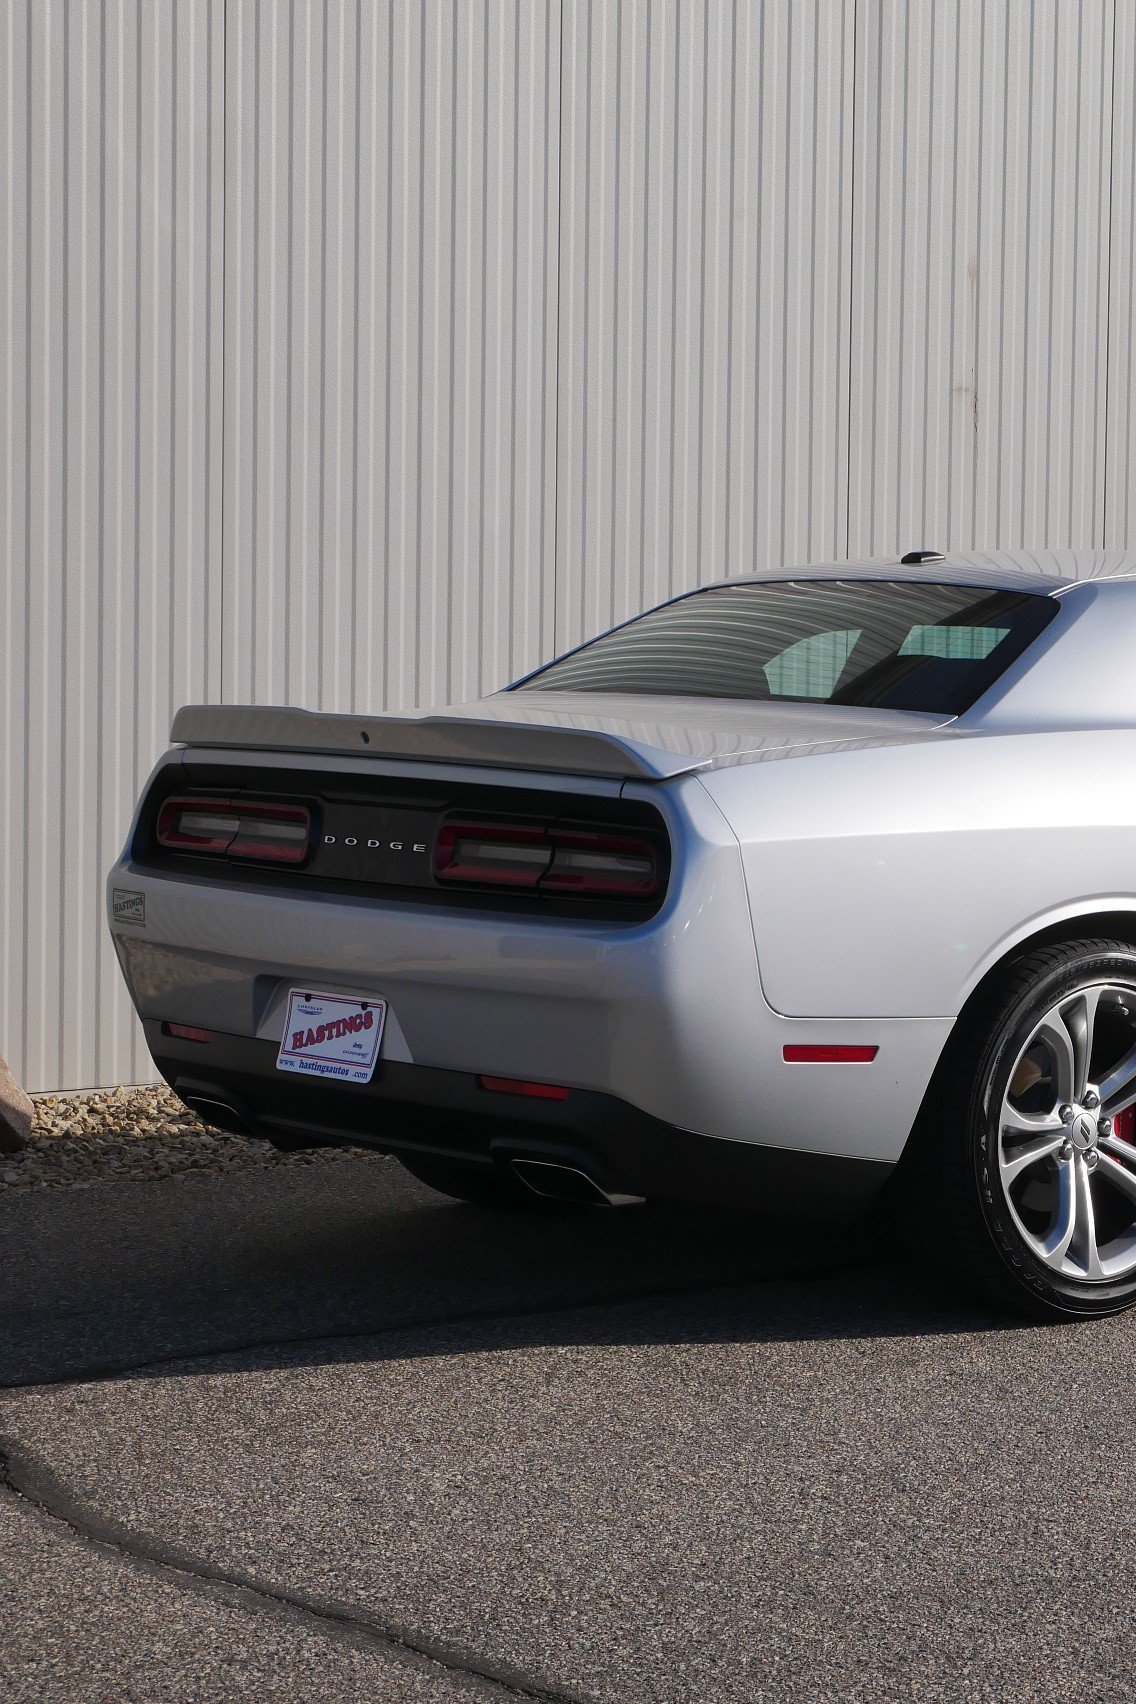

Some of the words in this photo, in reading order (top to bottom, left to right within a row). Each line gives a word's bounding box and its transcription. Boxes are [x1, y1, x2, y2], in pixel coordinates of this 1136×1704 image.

[324, 835, 426, 853] DODGE
[292, 1011, 373, 1050] HASTINGS
[299, 1059, 349, 1075] hastingsautos
